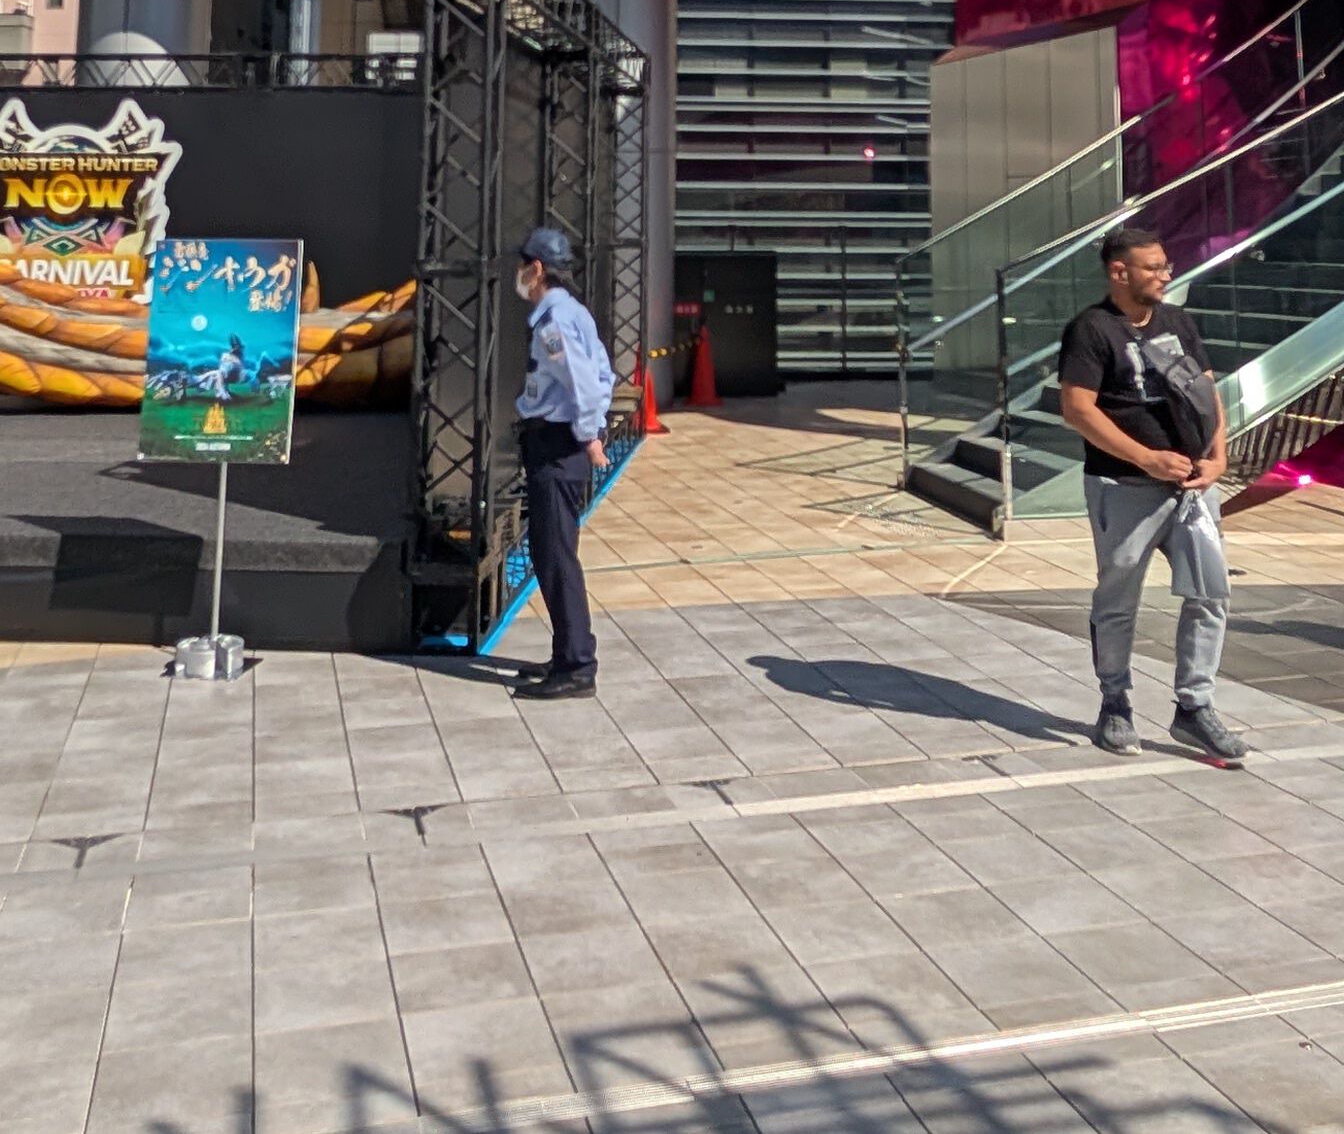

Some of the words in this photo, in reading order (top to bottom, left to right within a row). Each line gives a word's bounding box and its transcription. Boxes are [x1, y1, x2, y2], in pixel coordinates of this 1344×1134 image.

[78, 157, 159, 172] HUNTER
[2, 173, 135, 215] NOW
[0, 258, 134, 286] ARNIVAL
